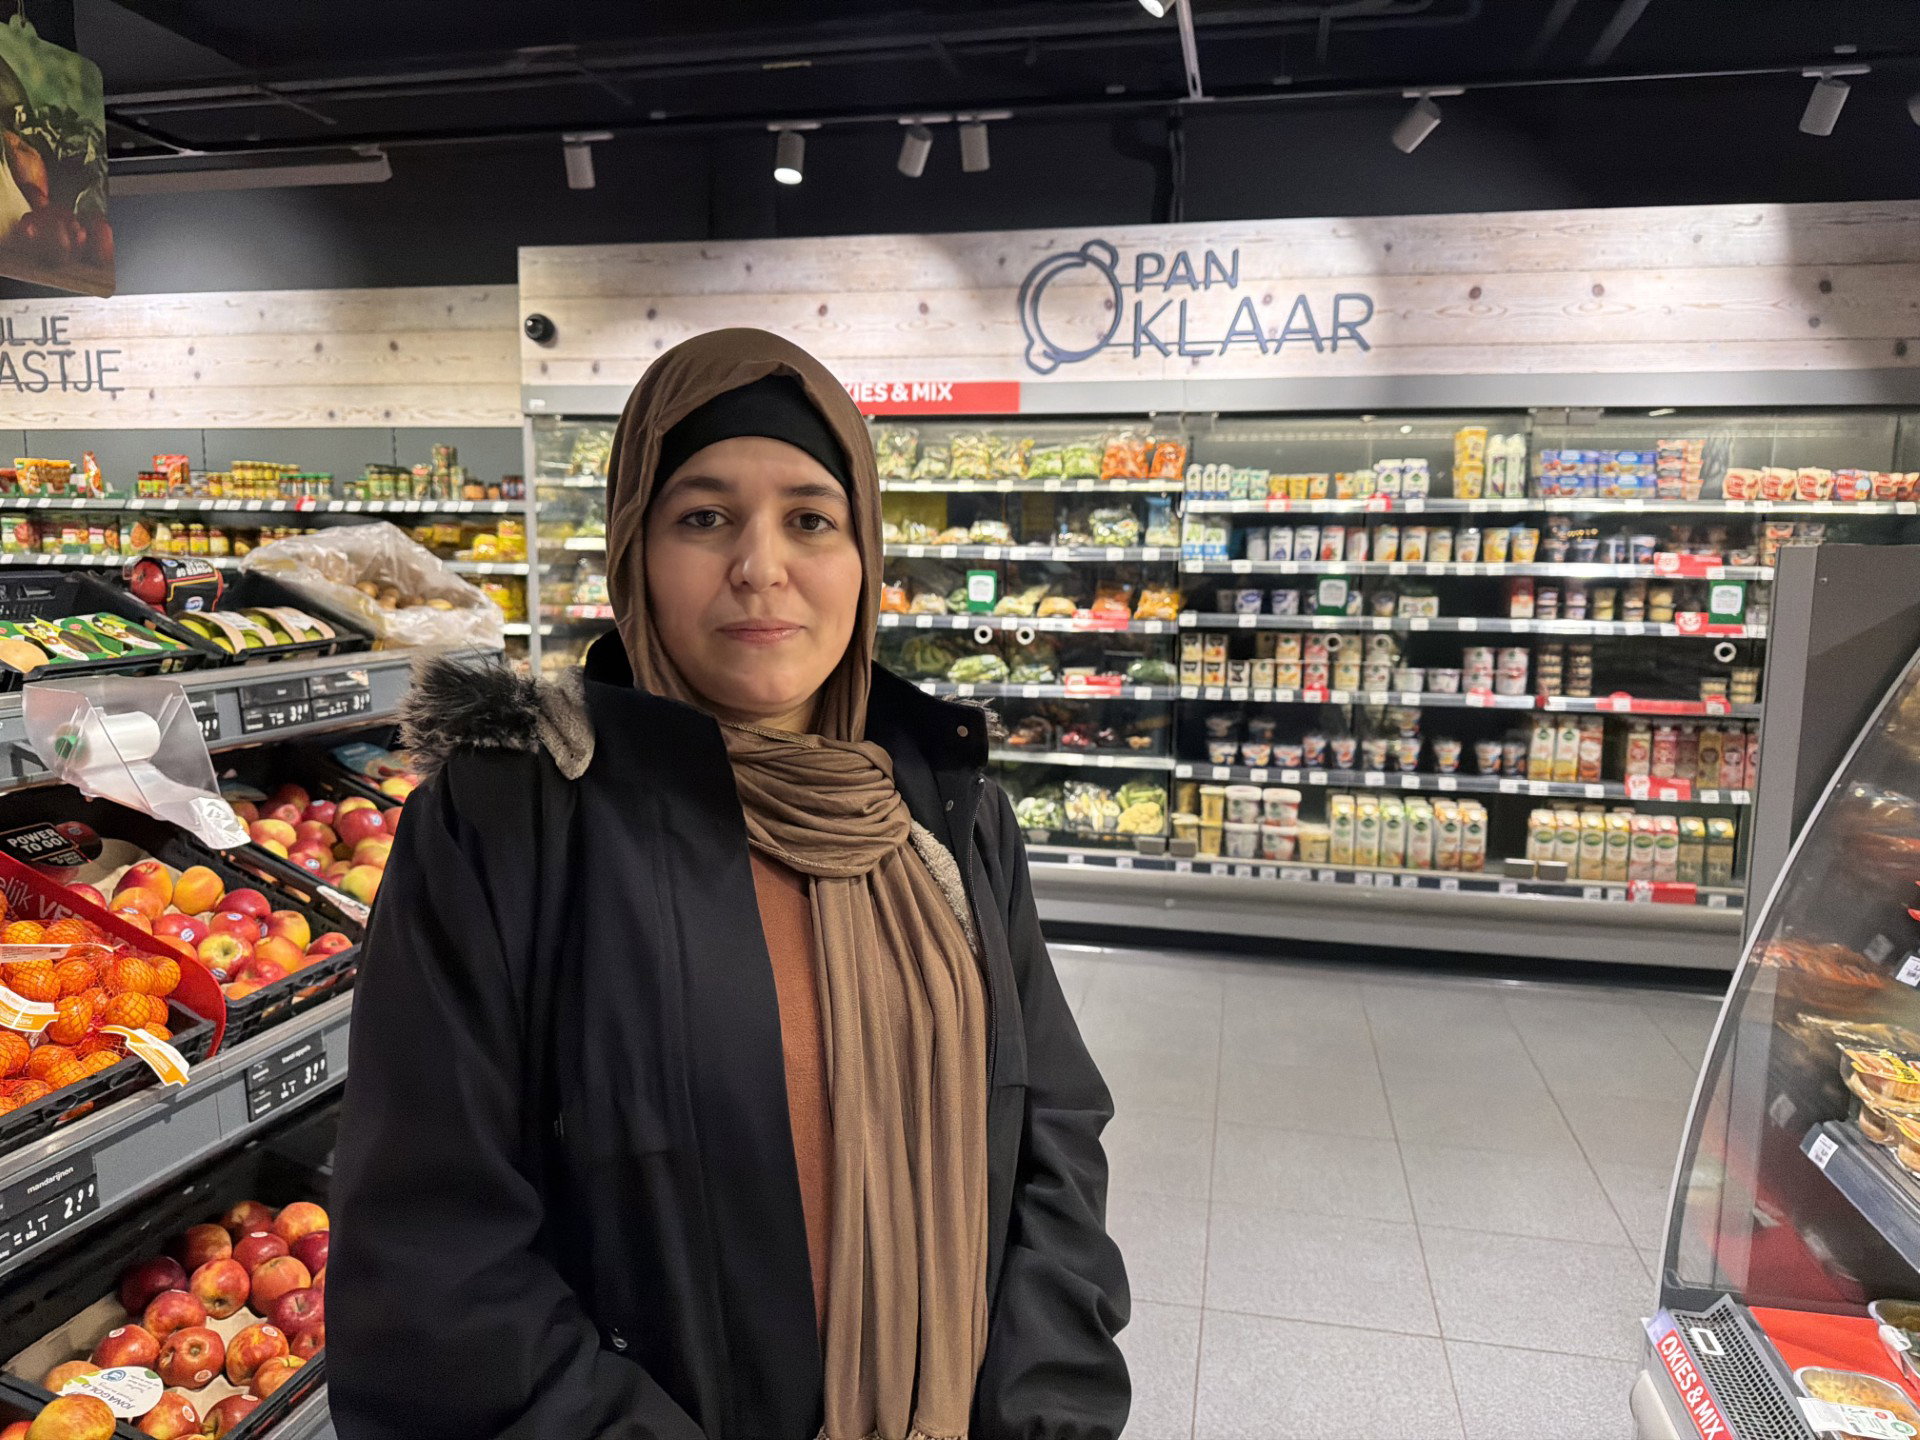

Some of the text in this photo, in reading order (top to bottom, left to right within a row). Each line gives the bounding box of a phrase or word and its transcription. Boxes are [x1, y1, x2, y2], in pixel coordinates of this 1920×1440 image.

[1135, 249, 1239, 293] PAN
[1133, 293, 1374, 359] KLAAR
[890, 382, 909, 403] &
[911, 382, 954, 403] MIX
[6, 828, 60, 848] POWER
[20, 843, 43, 854] TO
[26, 1166, 75, 1195] mandarijnen
[1686, 1385, 1705, 1409] &
[1693, 1399, 1725, 1440] MIX
